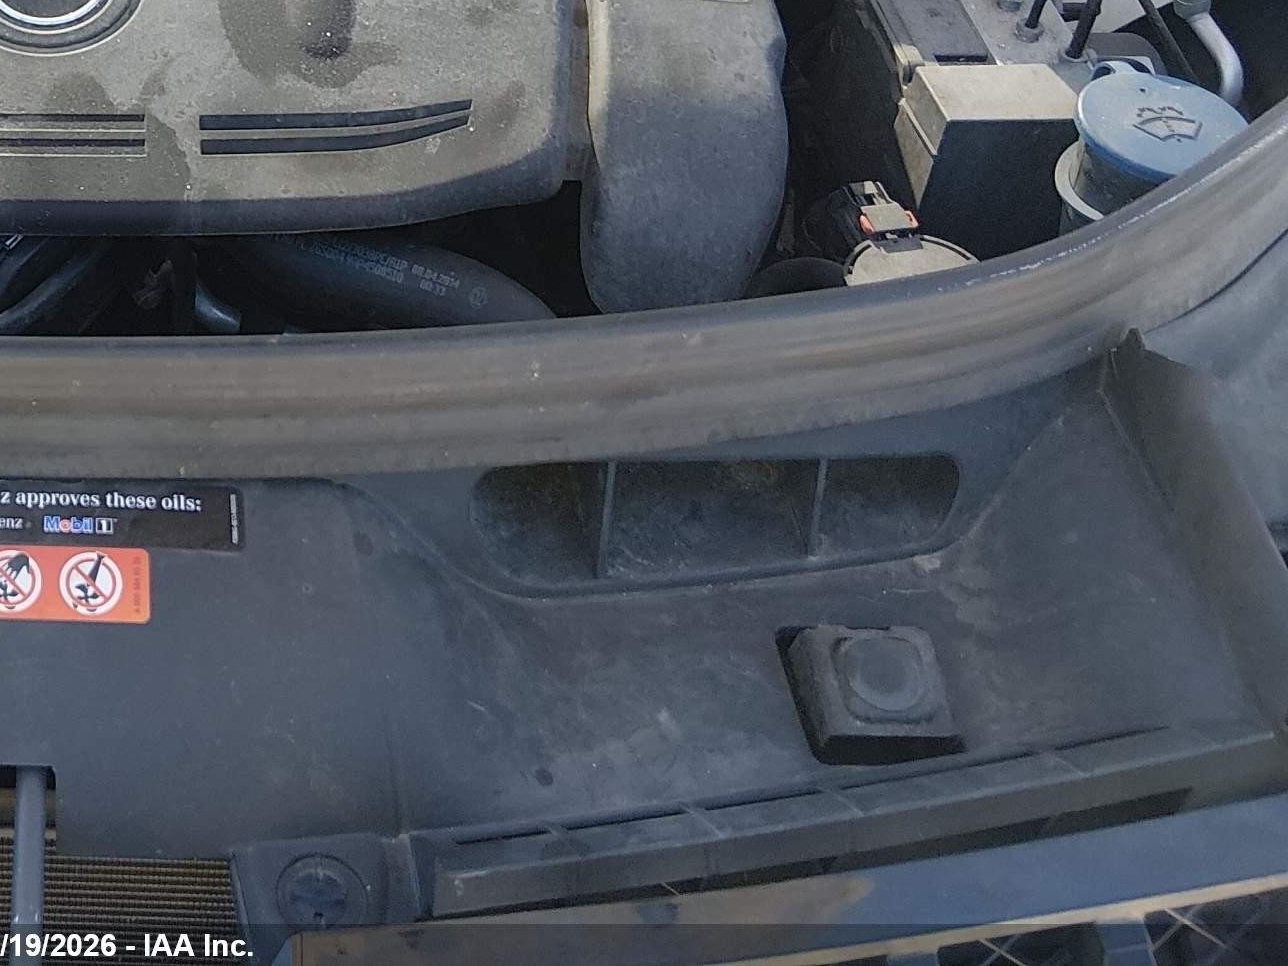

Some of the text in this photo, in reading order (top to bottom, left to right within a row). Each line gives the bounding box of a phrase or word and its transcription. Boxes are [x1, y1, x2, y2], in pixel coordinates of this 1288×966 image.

[15, 490, 100, 509] approves
[105, 491, 157, 510] these
[161, 493, 202, 512] oils:
[43, 515, 93, 534] Mobil
